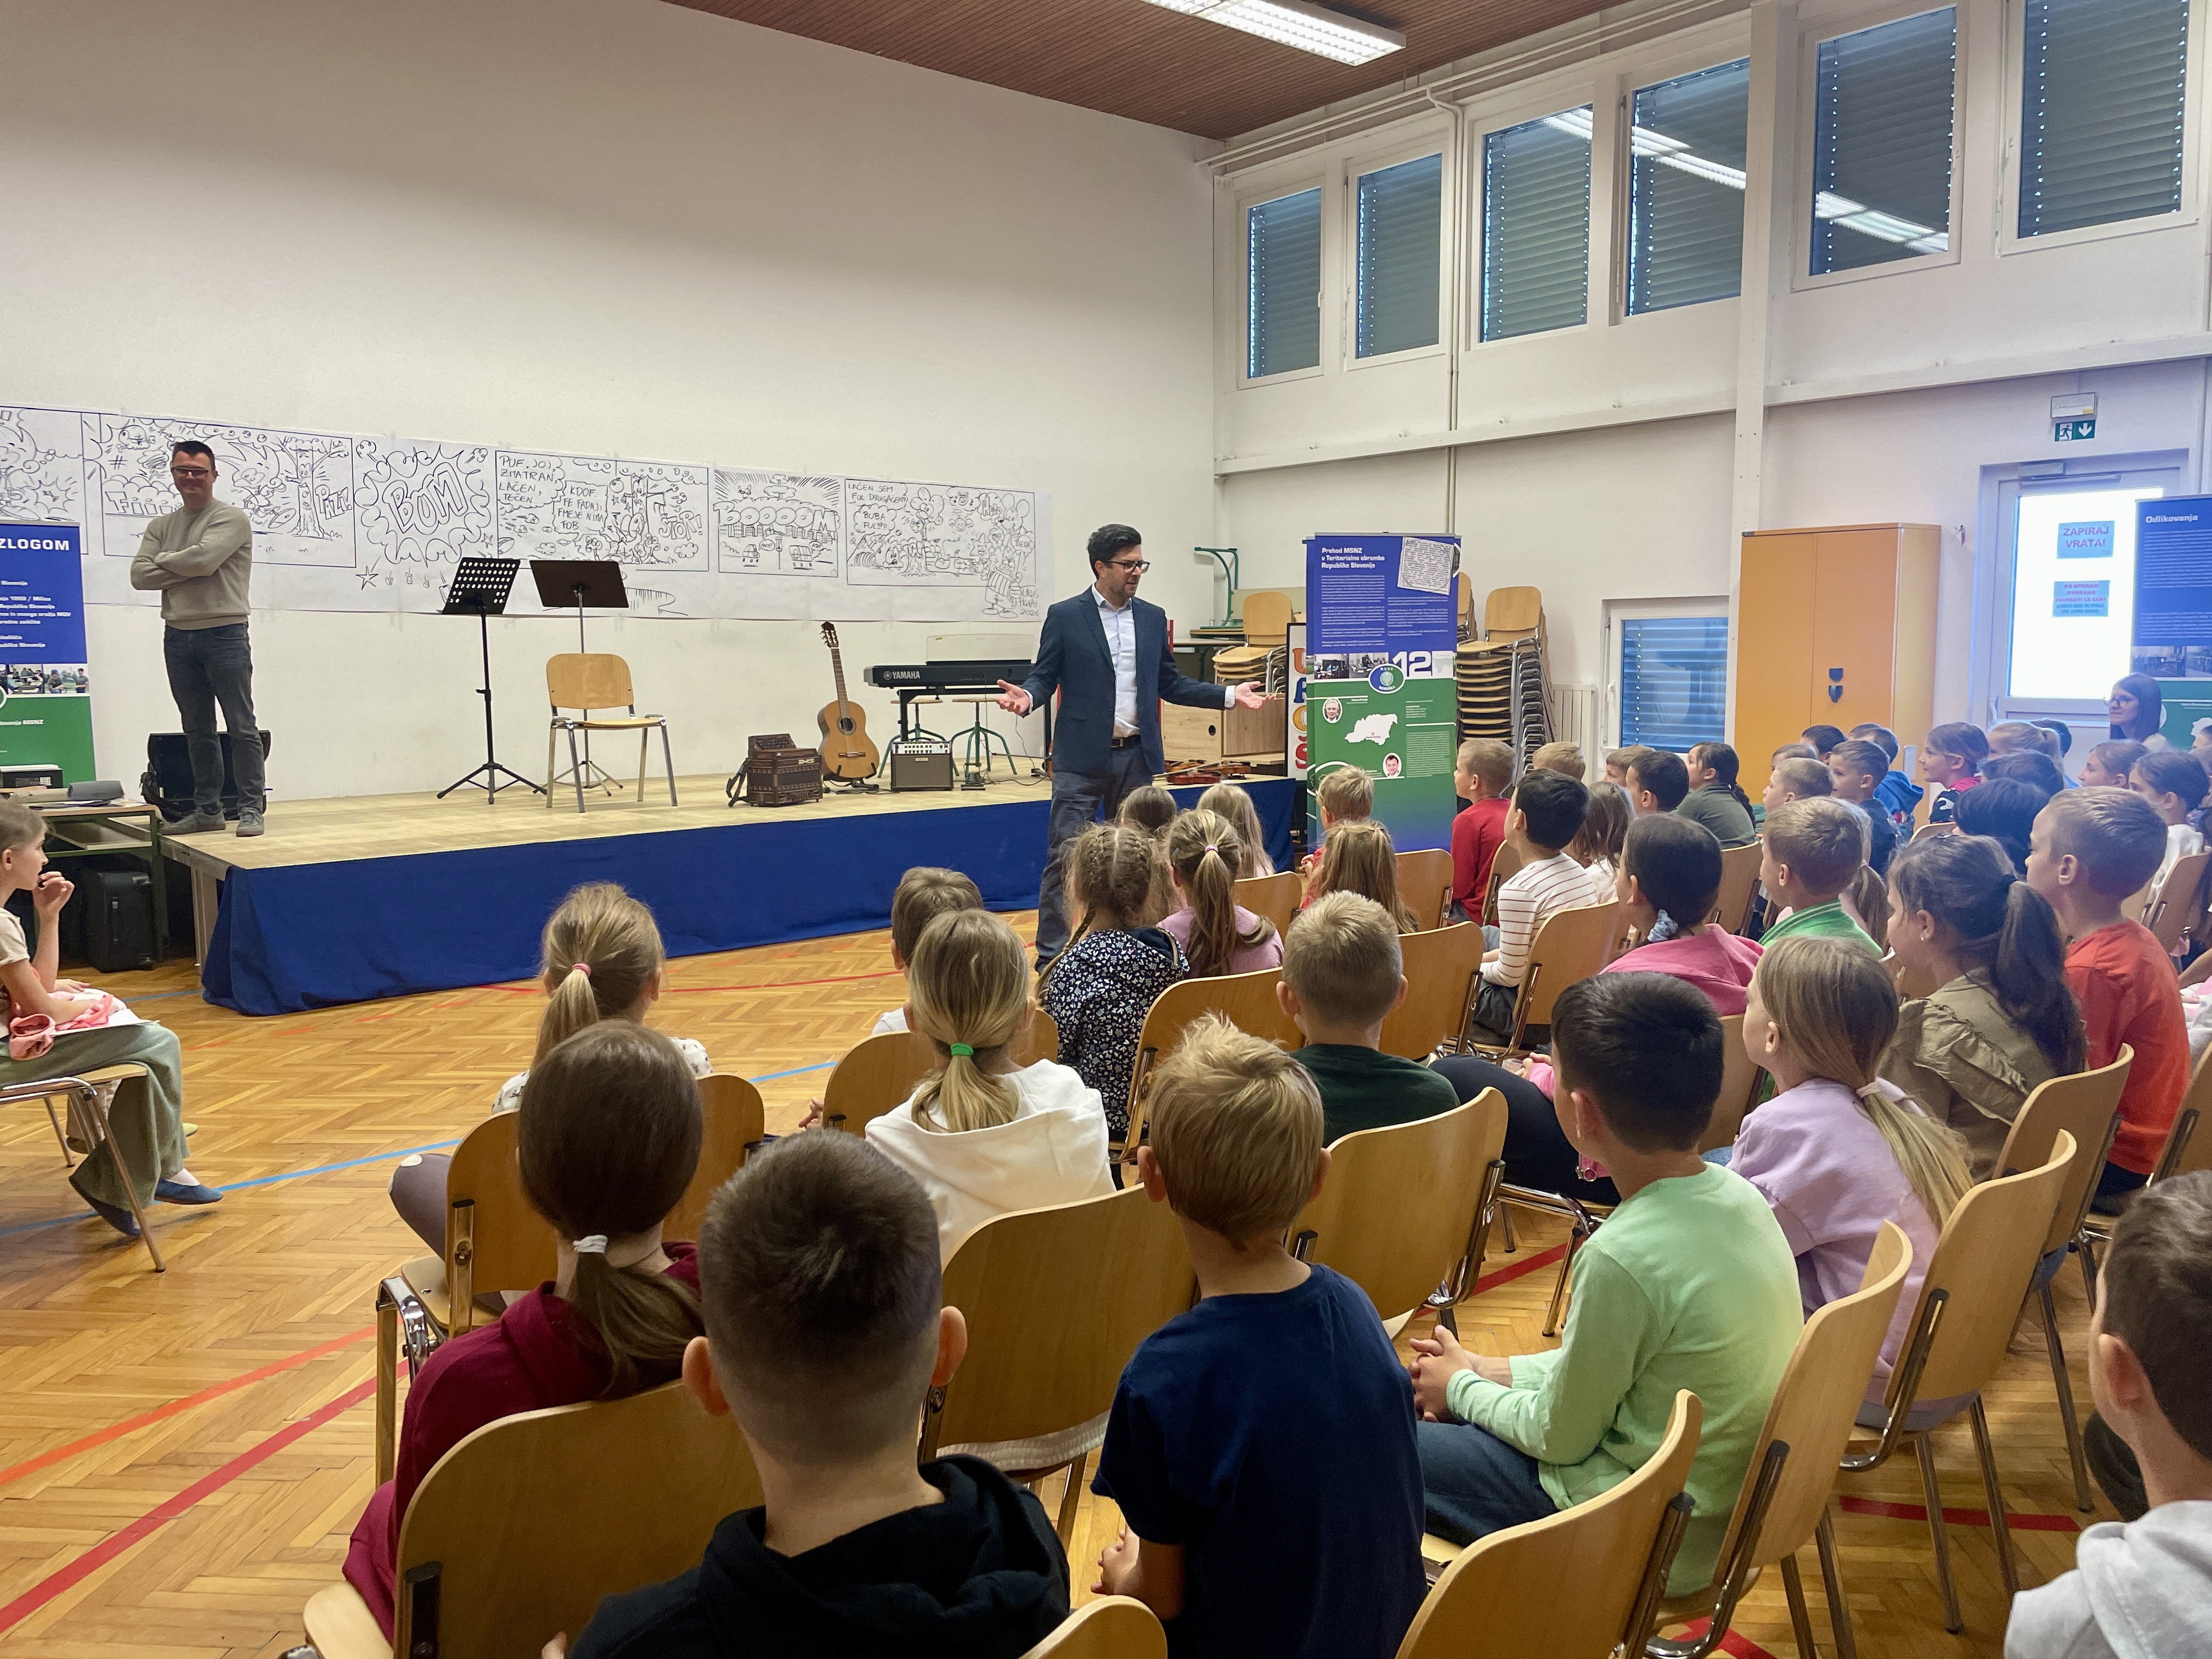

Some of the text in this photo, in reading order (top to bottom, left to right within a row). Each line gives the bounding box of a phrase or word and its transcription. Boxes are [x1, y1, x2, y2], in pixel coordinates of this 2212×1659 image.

[382, 462, 469, 534] BUM
[862, 511, 886, 521] BUBA
[2146, 514, 2198, 523] Odlikovanja
[561, 521, 579, 530] FOB
[2063, 527, 2109, 536] ZAPIRAJ
[2066, 539, 2106, 548] VRATA!
[892, 671, 920, 679] YAMAHA
